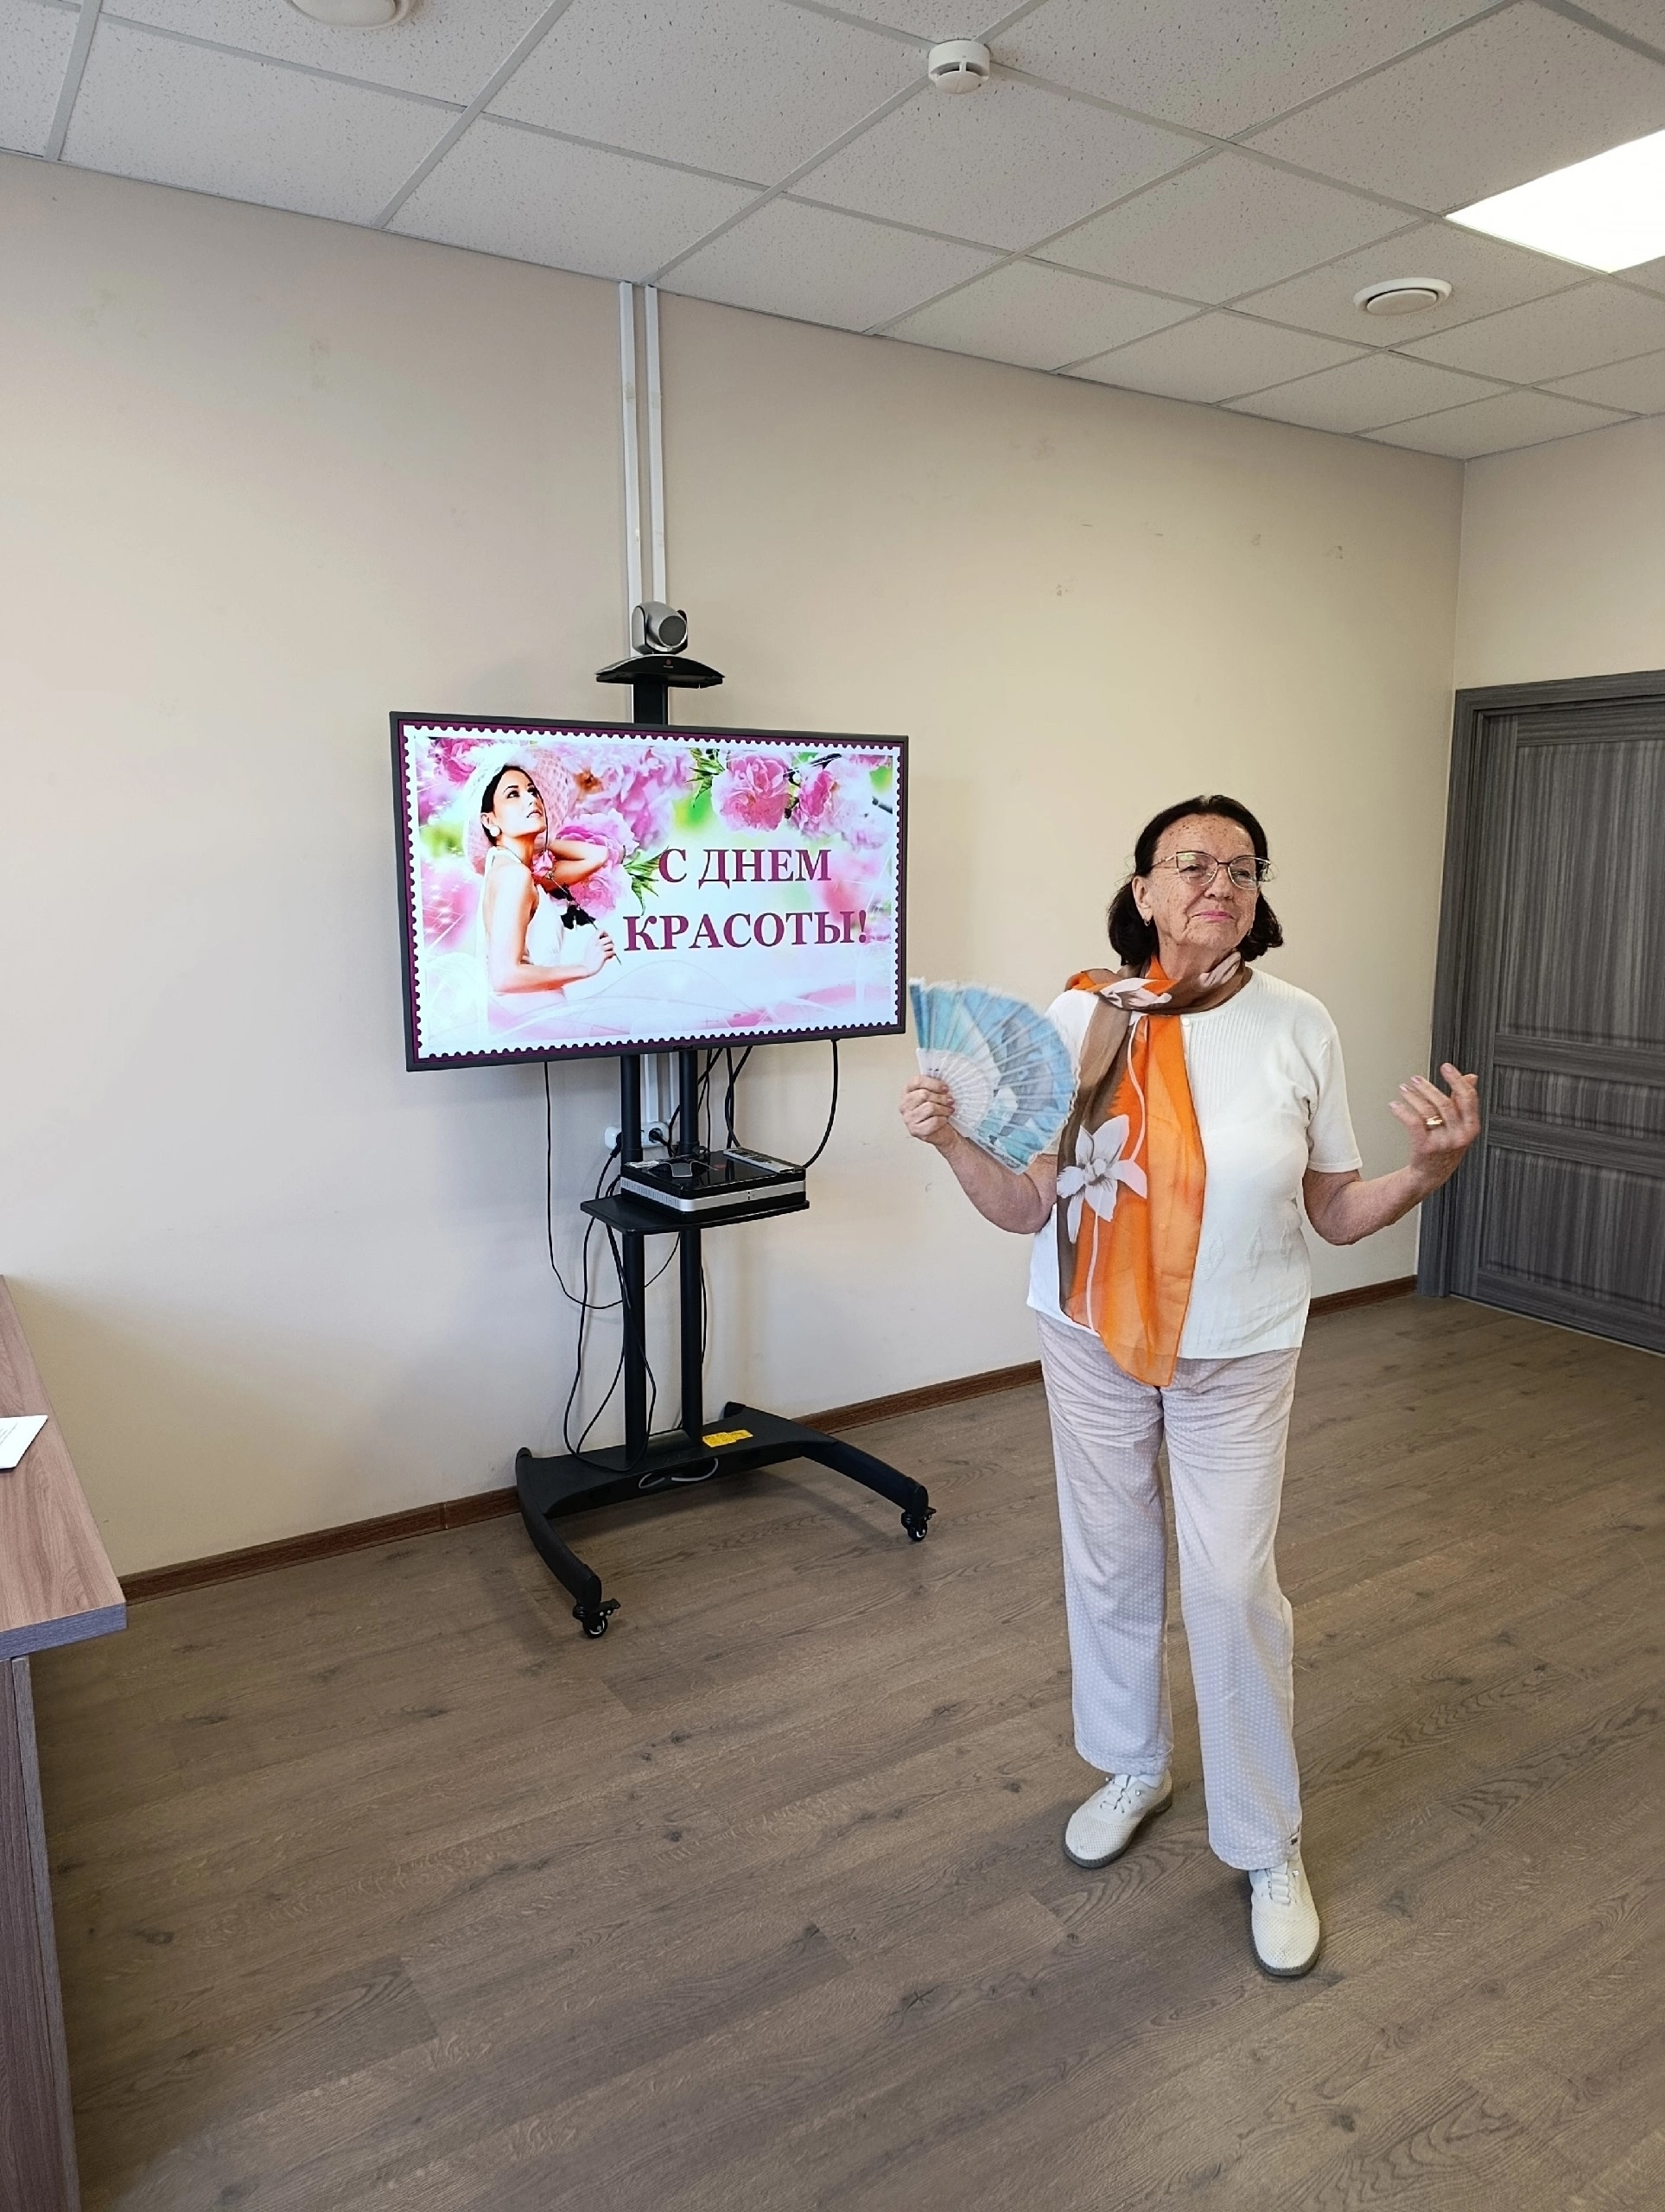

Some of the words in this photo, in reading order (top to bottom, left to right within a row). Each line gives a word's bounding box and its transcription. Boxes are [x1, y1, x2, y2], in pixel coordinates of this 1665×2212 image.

[658, 849, 688, 883] С
[698, 849, 832, 890] ДНЕМ
[623, 909, 867, 951] КРАСОТЫ!
